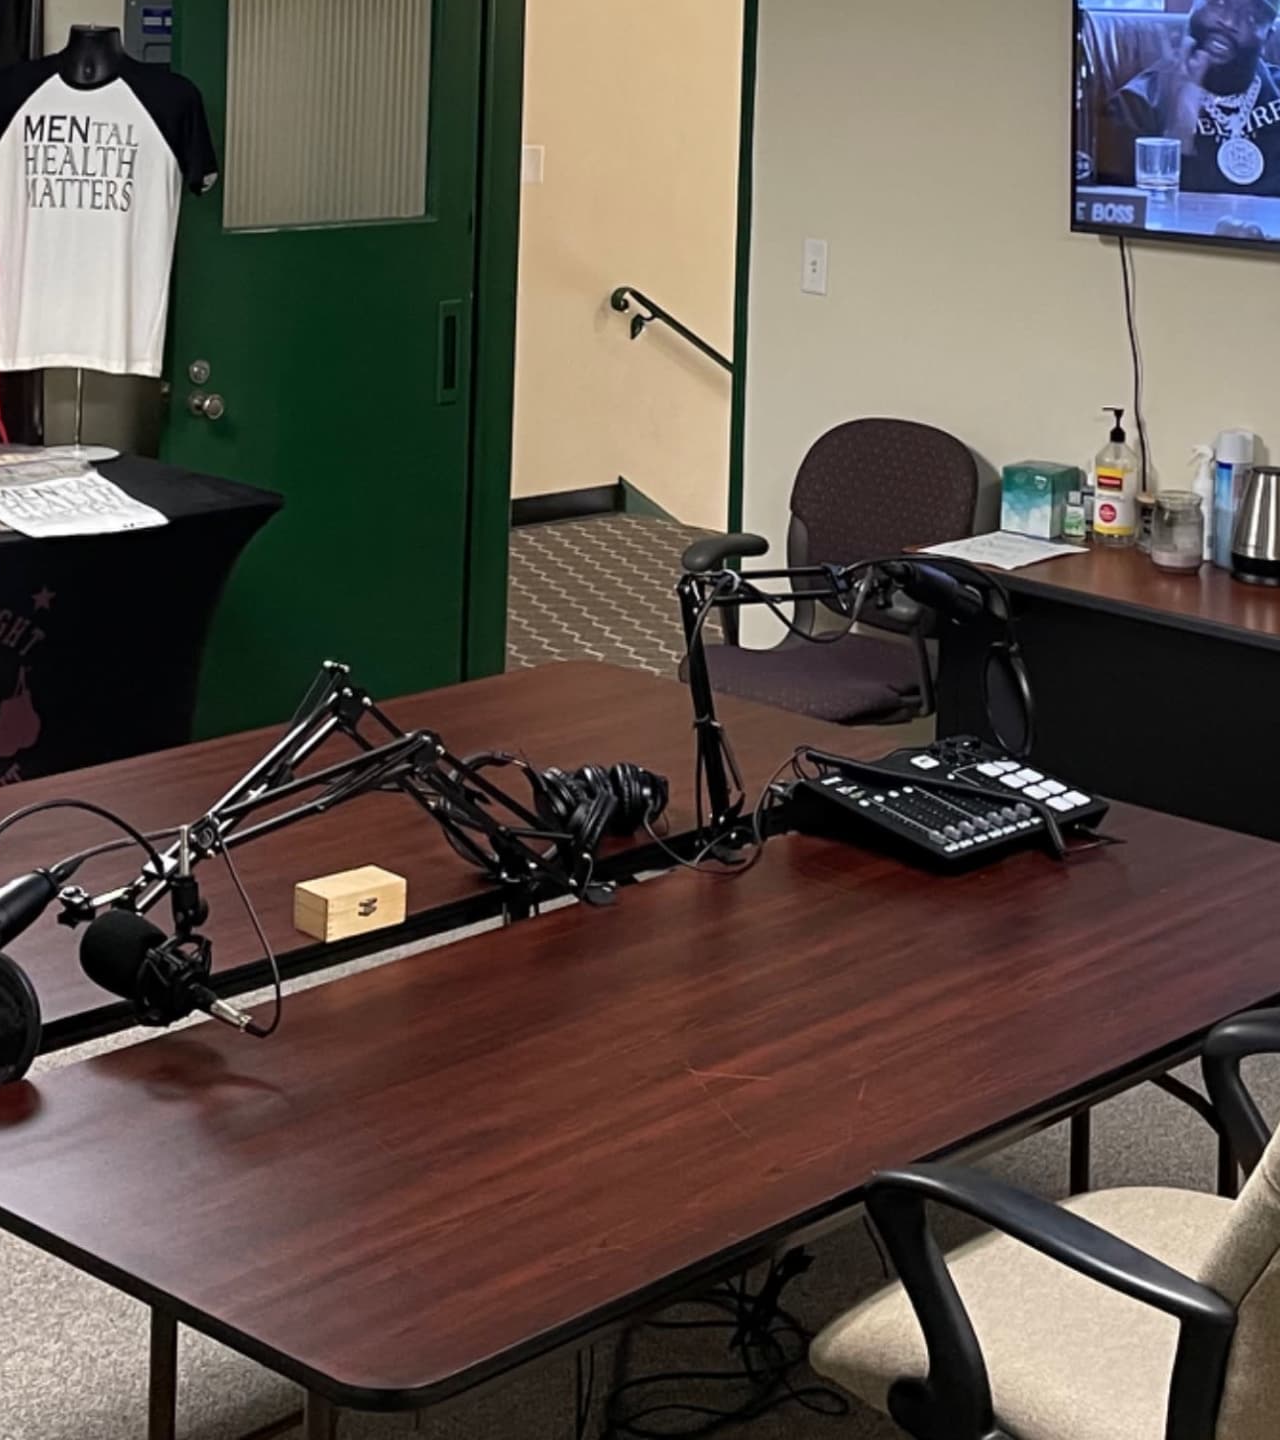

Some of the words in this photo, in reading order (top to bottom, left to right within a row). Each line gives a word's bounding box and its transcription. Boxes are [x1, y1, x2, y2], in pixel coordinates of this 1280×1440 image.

[24, 115, 138, 147] MENTAL
[24, 144, 138, 179] HEALTH
[1091, 202, 1135, 224] BOSS
